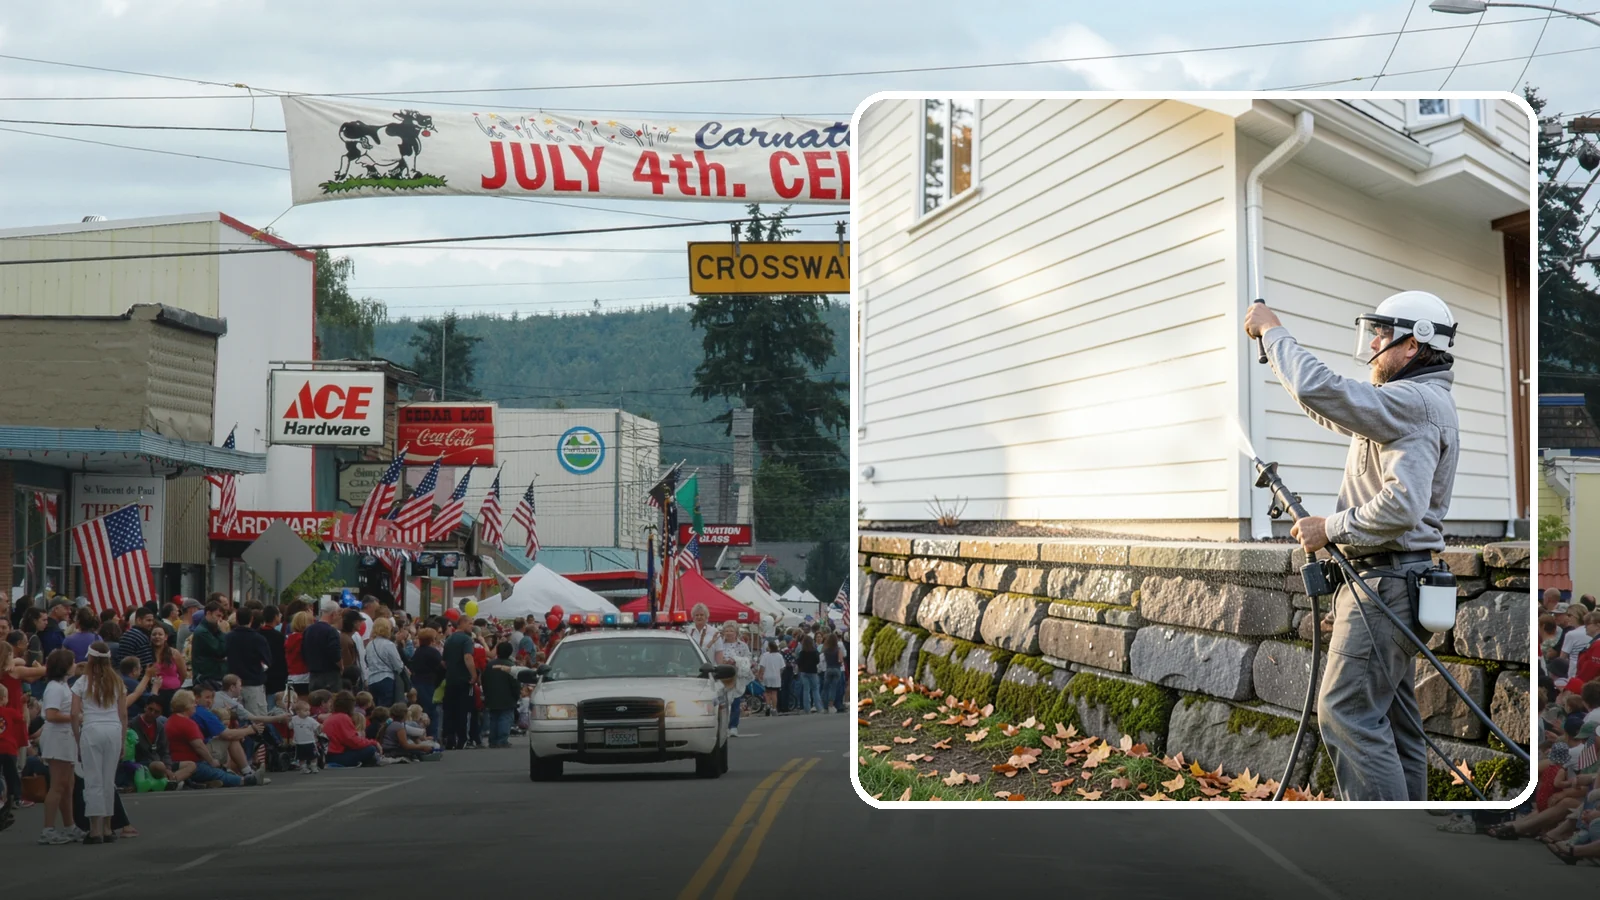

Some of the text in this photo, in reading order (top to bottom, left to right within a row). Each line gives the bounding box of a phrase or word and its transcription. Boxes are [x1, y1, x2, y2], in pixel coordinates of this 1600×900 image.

[695, 121, 850, 149] Carnat
[481, 140, 605, 192] JULY
[632, 150, 746, 197] 4th.
[697, 254, 850, 279] CROSSWA
[282, 380, 373, 420] ACE
[405, 409, 453, 422] CEDAR
[283, 421, 371, 437] Hardware
[83, 484, 155, 495] St. Vincent de Paul
[688, 526, 741, 535] CRNATION
[699, 535, 730, 543] GLASS
